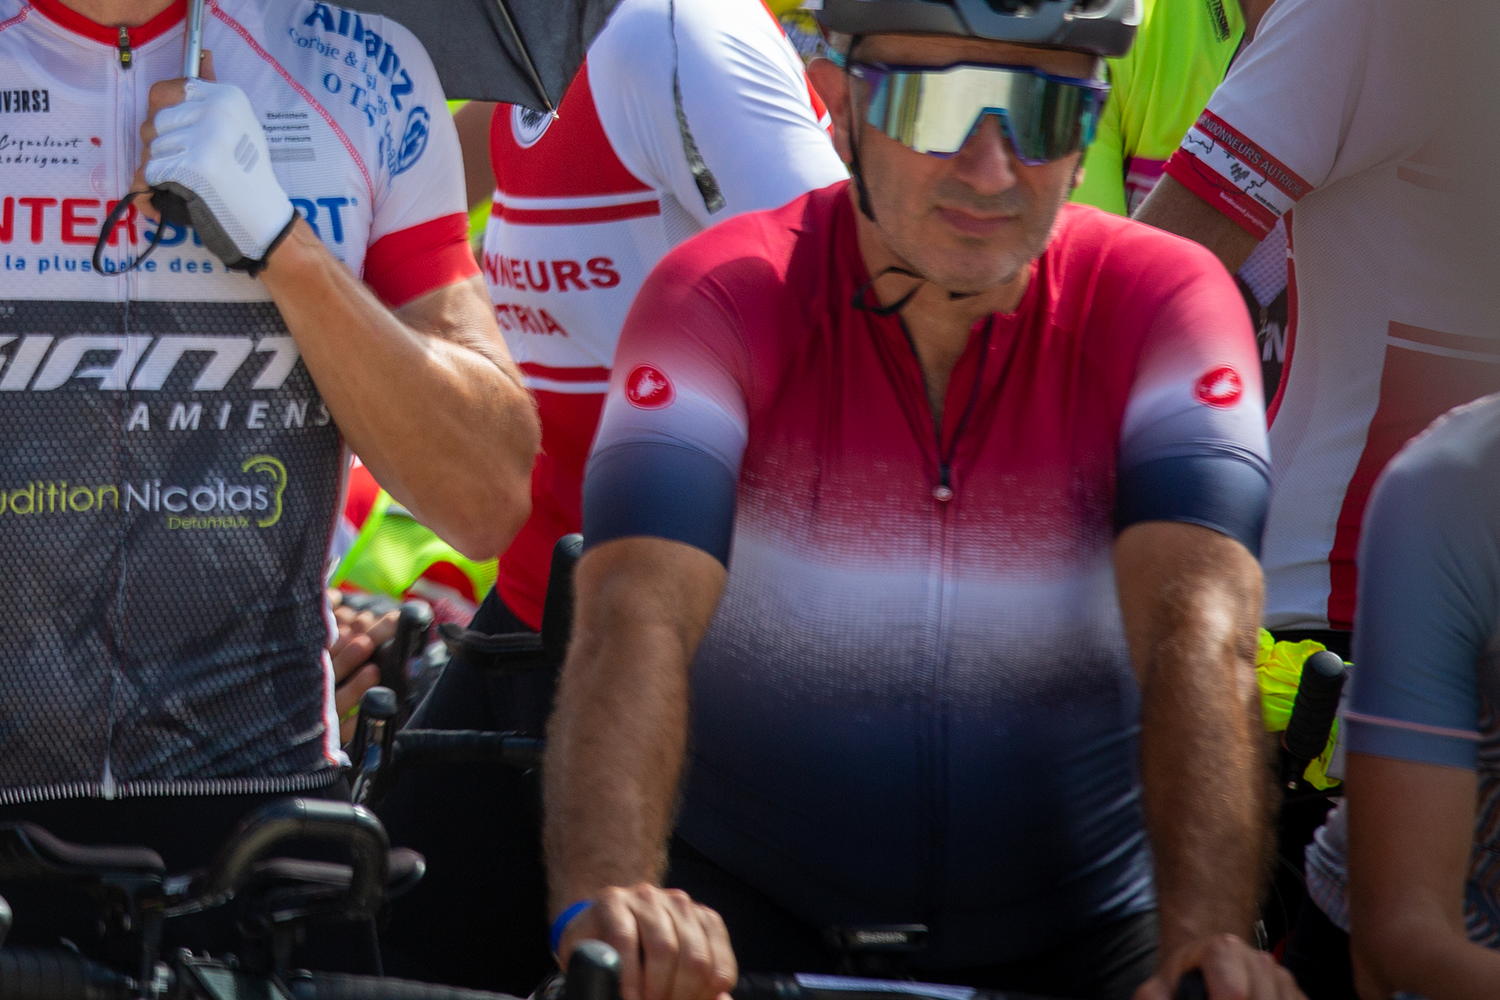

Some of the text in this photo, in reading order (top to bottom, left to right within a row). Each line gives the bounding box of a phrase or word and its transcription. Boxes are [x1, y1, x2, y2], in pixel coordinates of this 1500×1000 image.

[5, 254, 26, 270] la
[38, 257, 94, 275] plus
[169, 257, 213, 274] des
